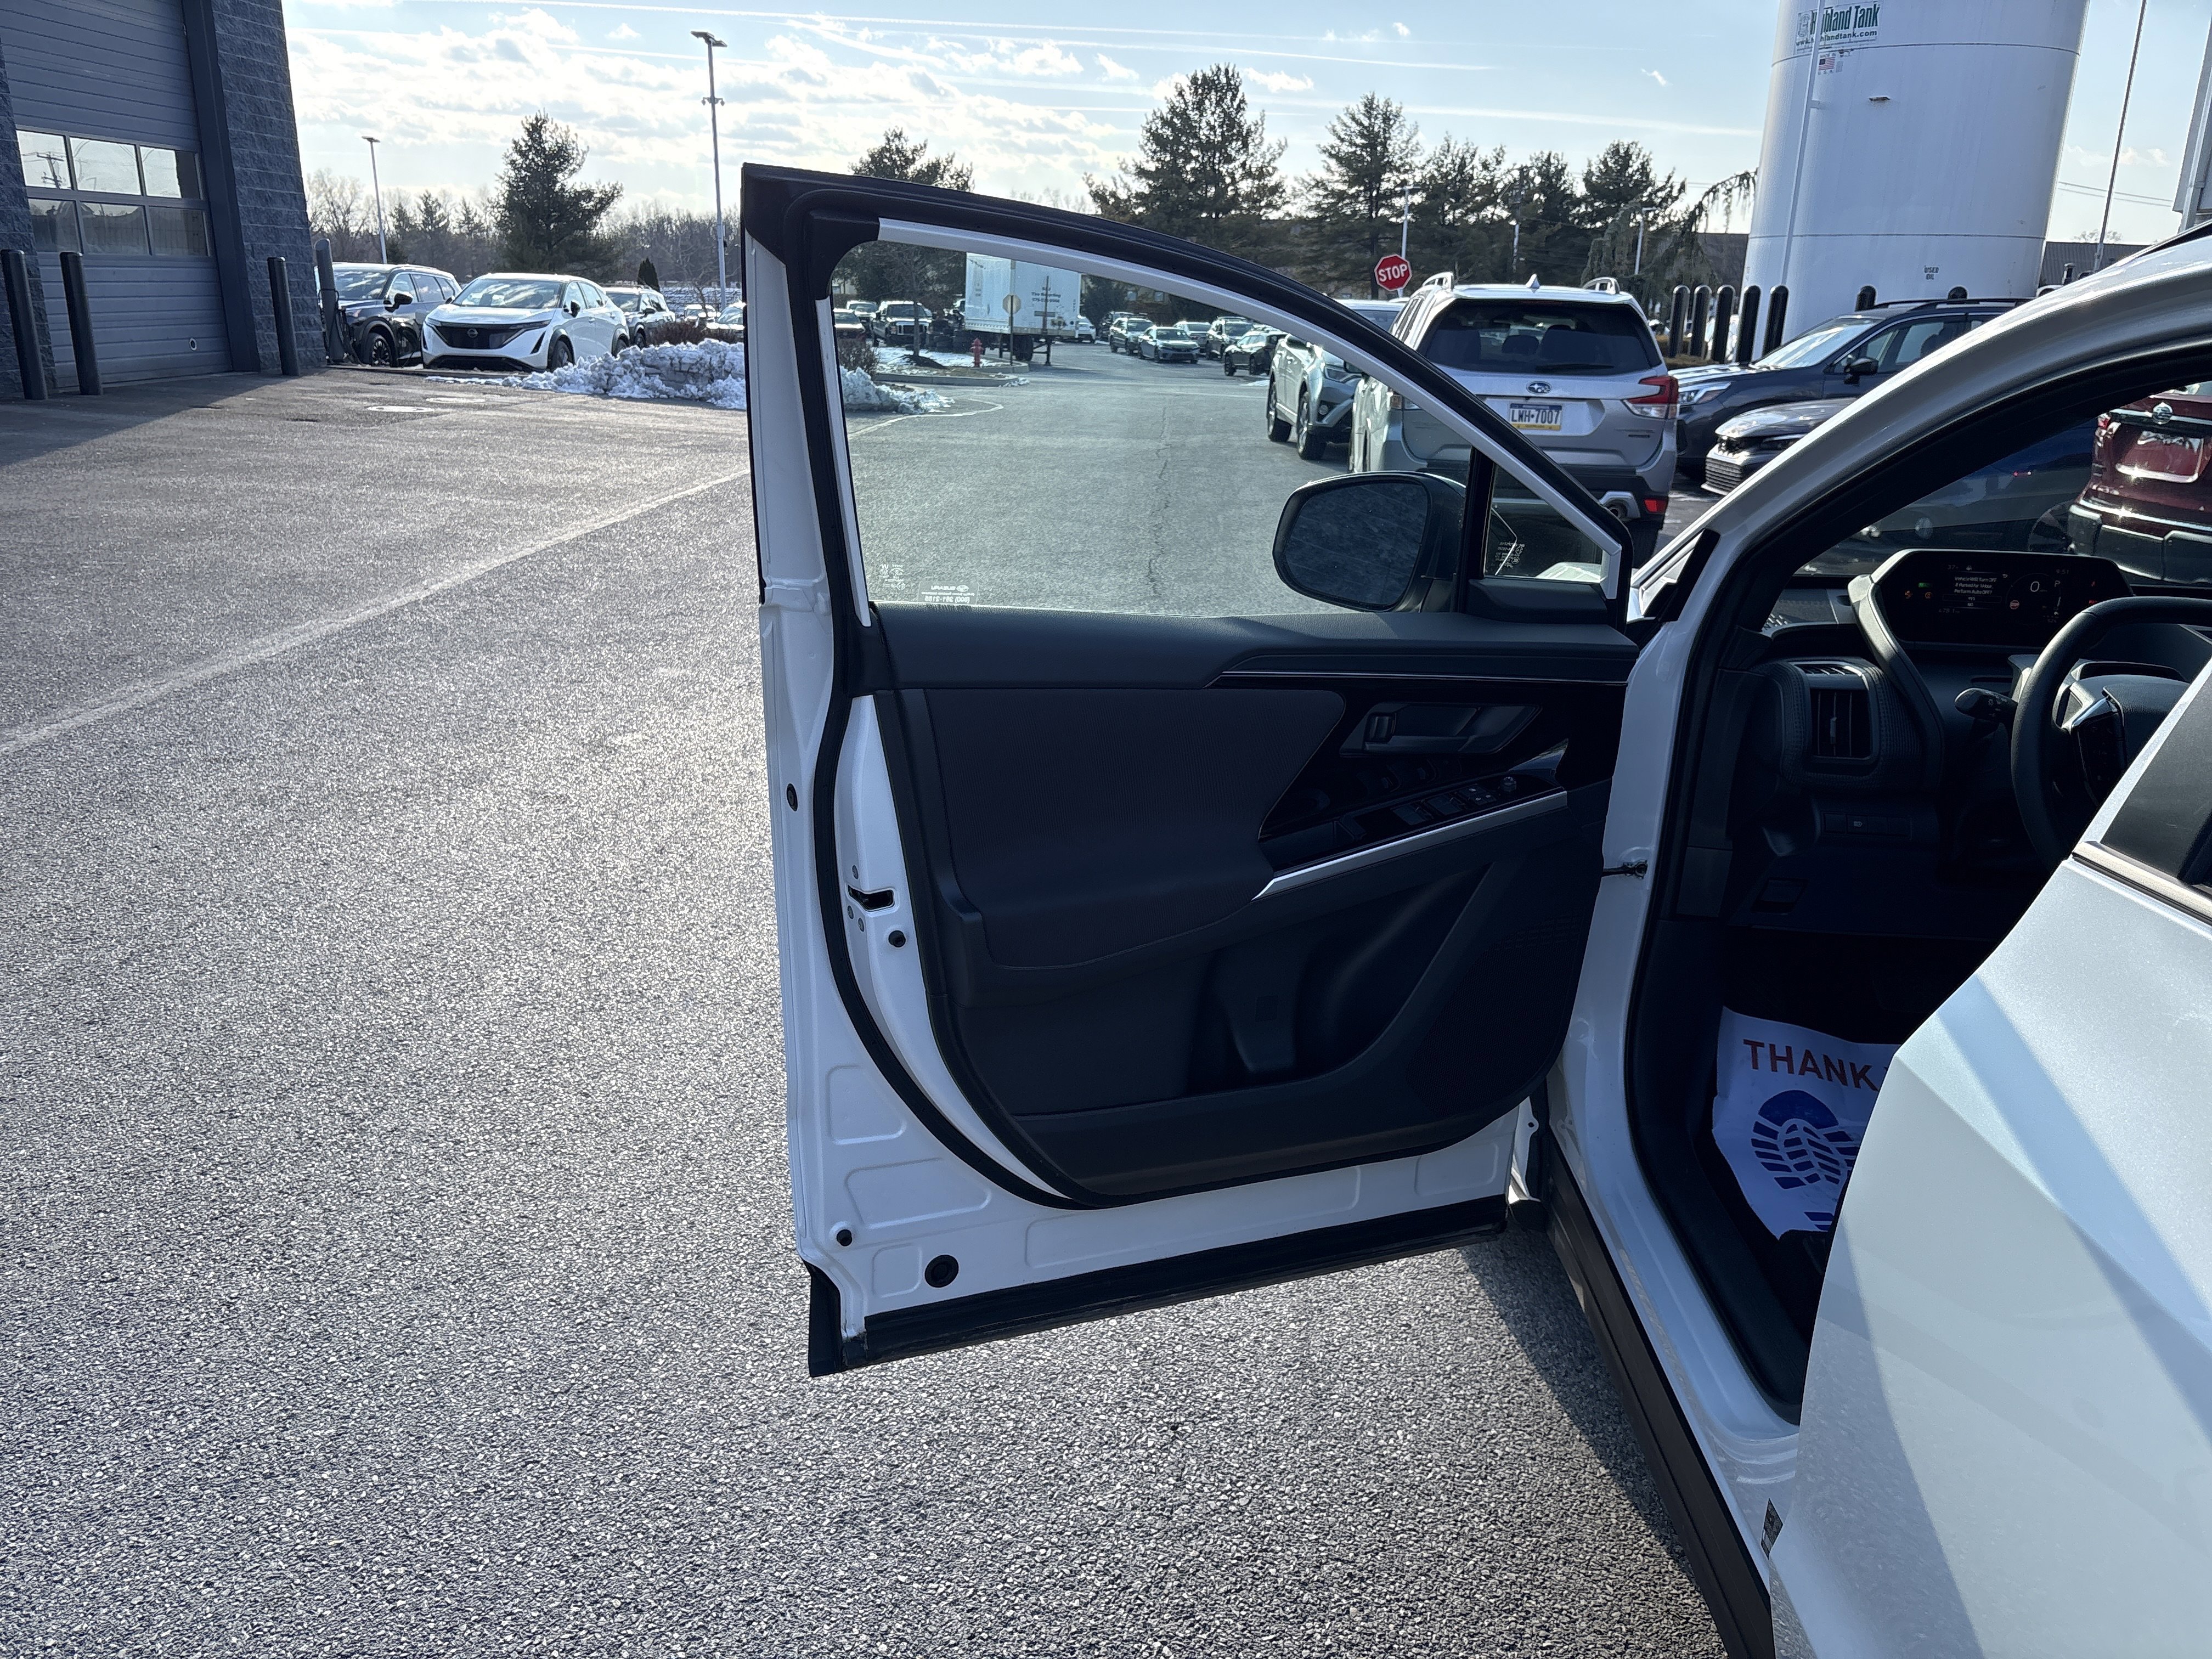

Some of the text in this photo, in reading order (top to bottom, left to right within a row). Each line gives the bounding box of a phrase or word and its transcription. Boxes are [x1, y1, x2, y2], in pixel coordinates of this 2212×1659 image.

[1810, 3, 1881, 35] Hhland Tank
[1378, 264, 1408, 283] STOP
[2030, 581, 2040, 592] 0
[1743, 1039, 1880, 1092] THANK
